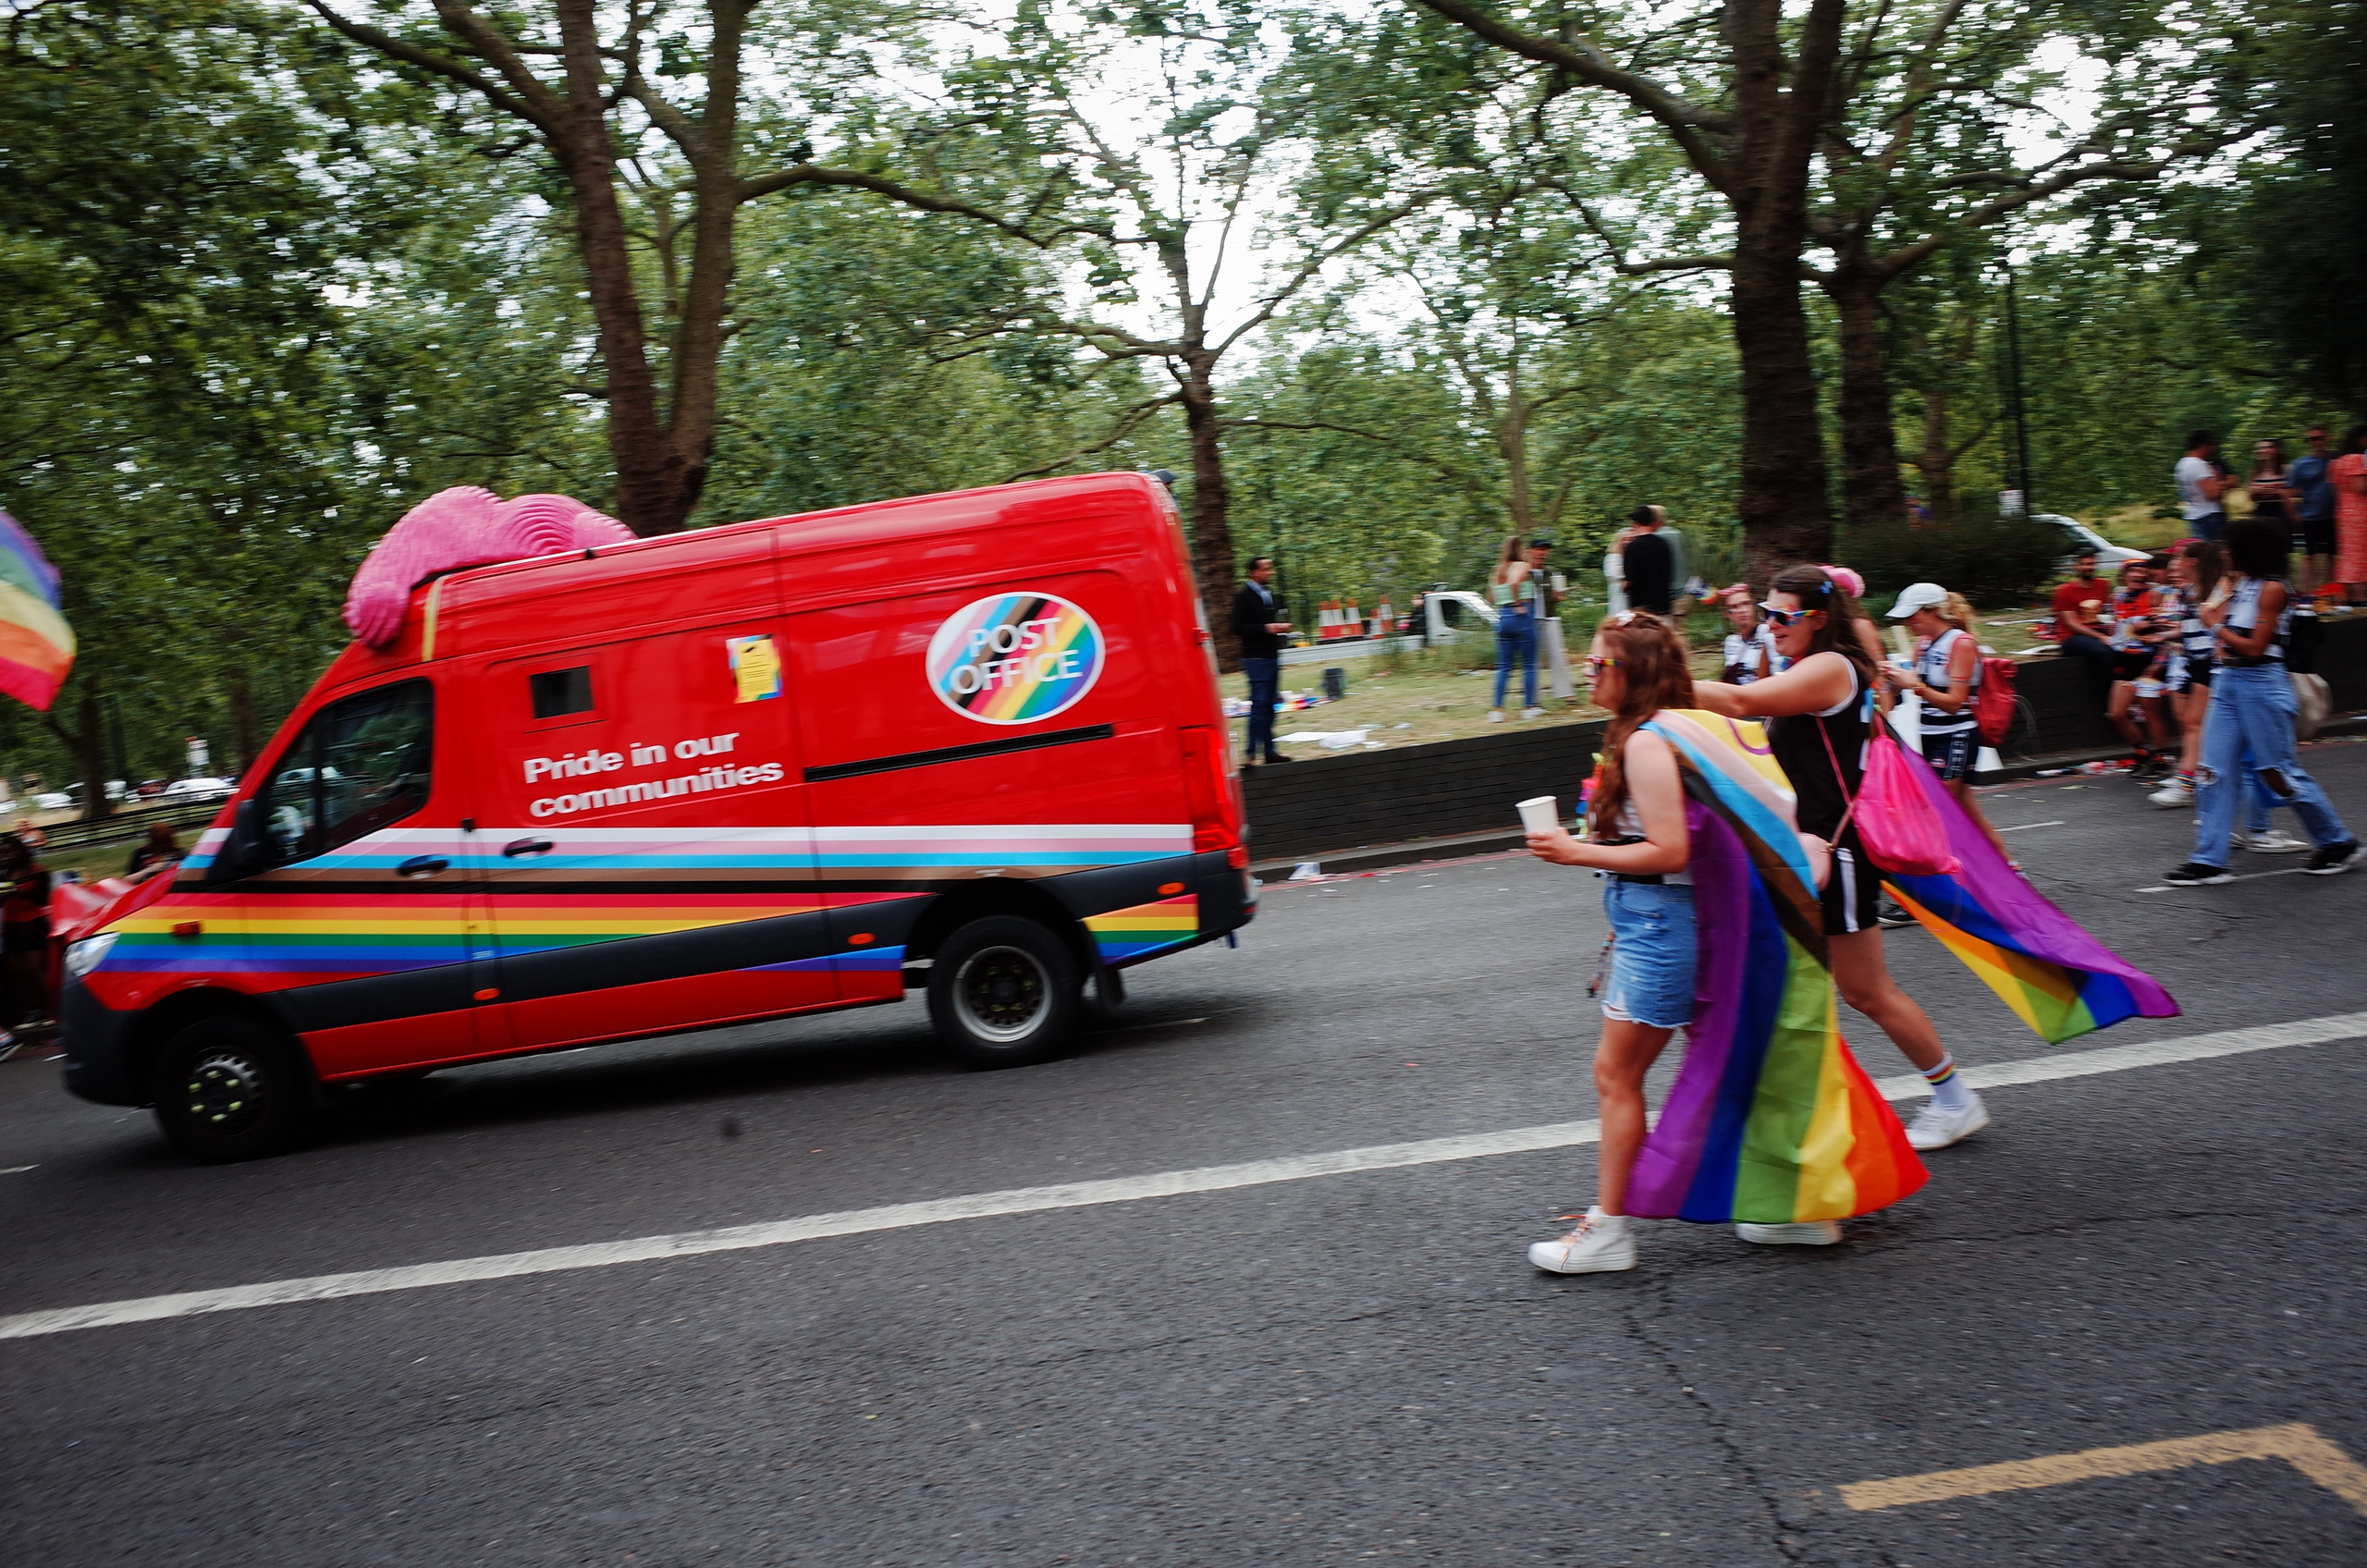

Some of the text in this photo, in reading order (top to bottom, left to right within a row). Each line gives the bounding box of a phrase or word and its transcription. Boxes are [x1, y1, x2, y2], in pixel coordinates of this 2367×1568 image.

[968, 617, 1062, 657] POST
[949, 650, 1083, 693] OFFICE
[523, 732, 739, 783] Pride in our
[530, 763, 784, 817] communities
